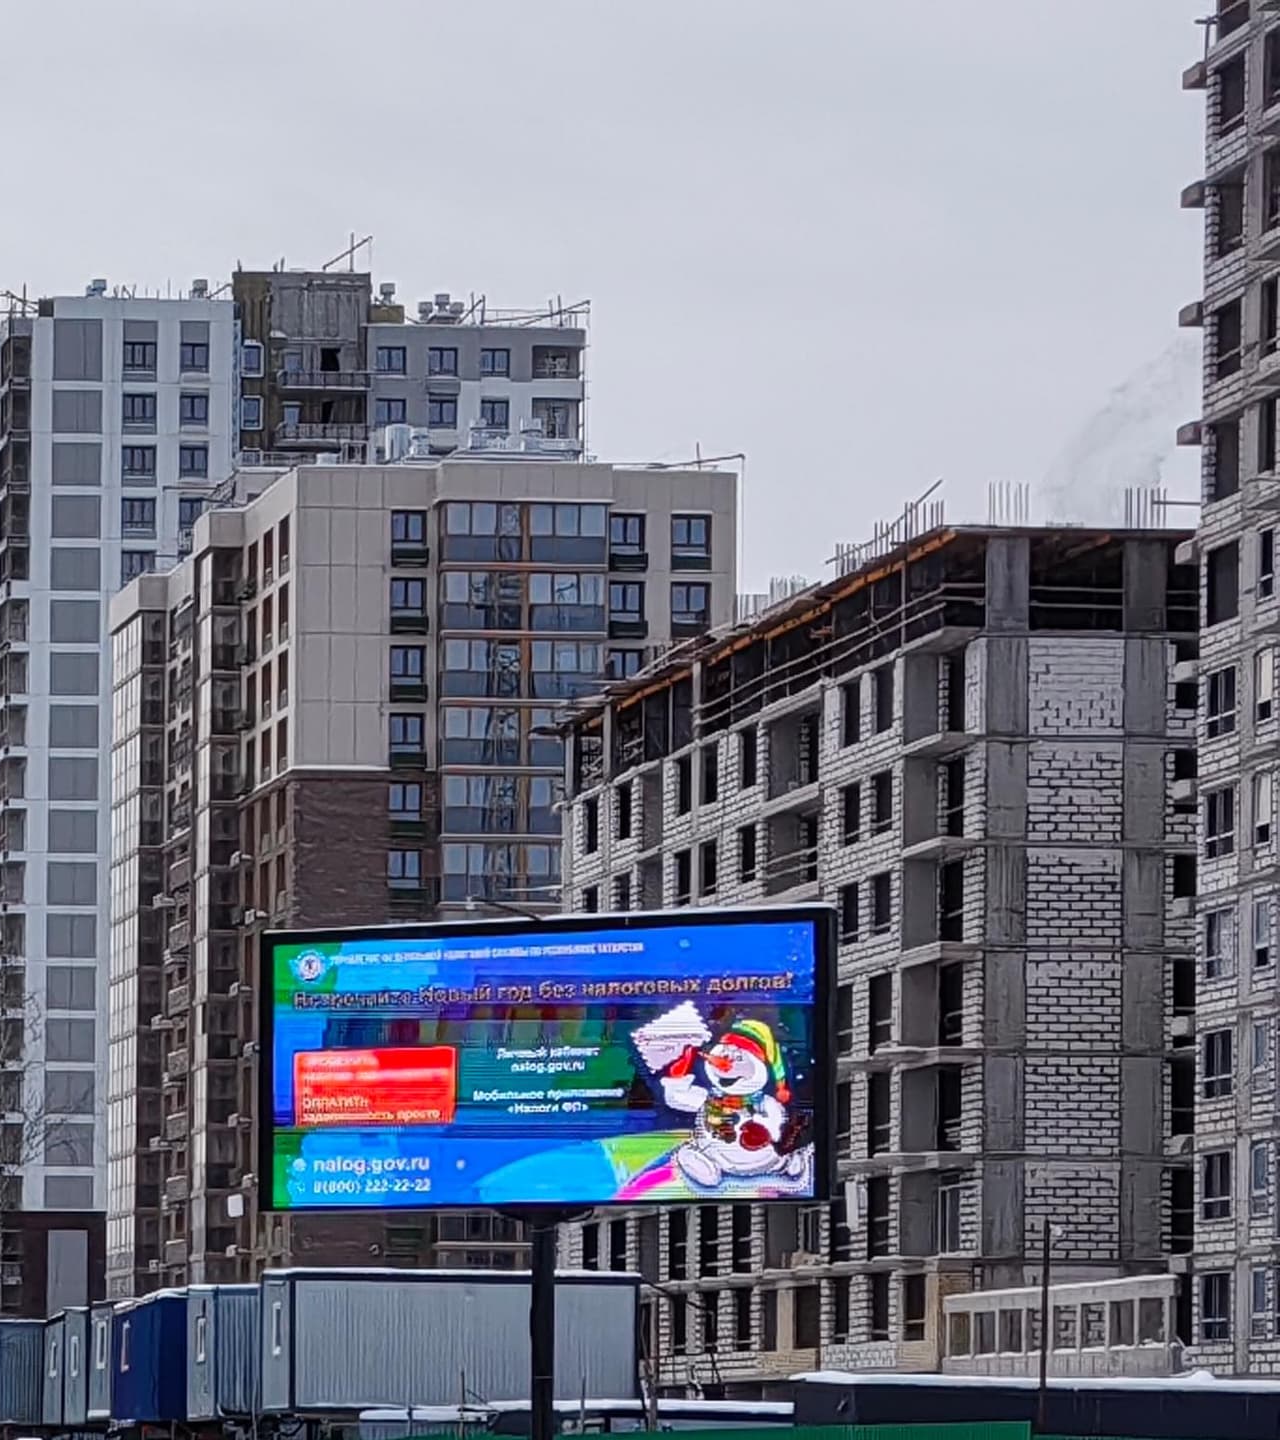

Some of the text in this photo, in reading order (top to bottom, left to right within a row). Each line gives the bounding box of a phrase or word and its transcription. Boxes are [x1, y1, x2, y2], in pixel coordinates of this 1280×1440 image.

[497, 984, 532, 1003] год
[538, 980, 576, 999] без
[581, 978, 701, 998] налоговых
[313, 1157, 430, 1176] nalog.gov.ru
[364, 1178, 432, 1193] 222-22-22
